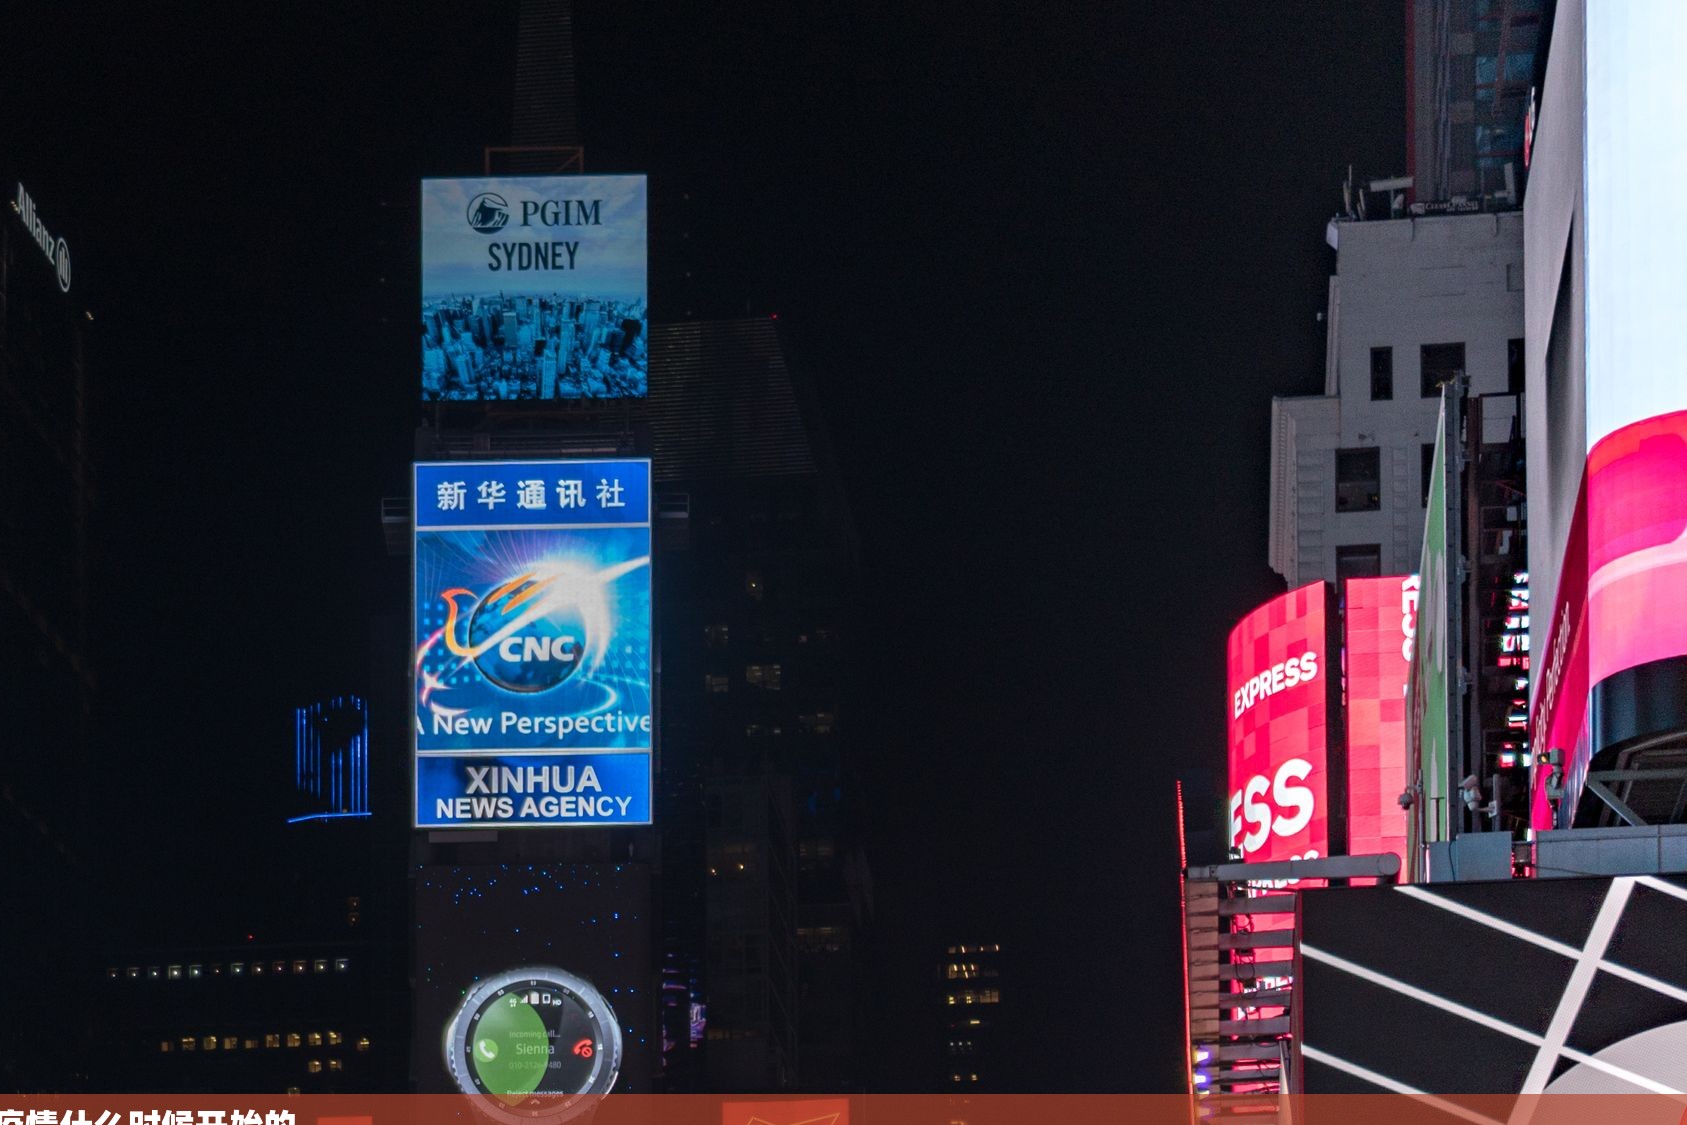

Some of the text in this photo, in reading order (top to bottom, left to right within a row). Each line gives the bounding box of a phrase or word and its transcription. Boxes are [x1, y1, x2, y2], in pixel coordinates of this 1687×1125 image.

[18, 181, 55, 265] Allianz
[520, 200, 602, 227] PGIM
[488, 242, 579, 271] SYDNEY
[437, 478, 626, 511] 新华通讯社
[498, 636, 576, 663] CNC
[1234, 651, 1318, 720] EXPRESS
[433, 710, 650, 740] New Perspective
[465, 766, 601, 794] XINHUA
[436, 796, 631, 819] NEWS AGENCY
[509, 1030, 542, 1040] Incoming
[515, 1043, 555, 1055] Sienna
